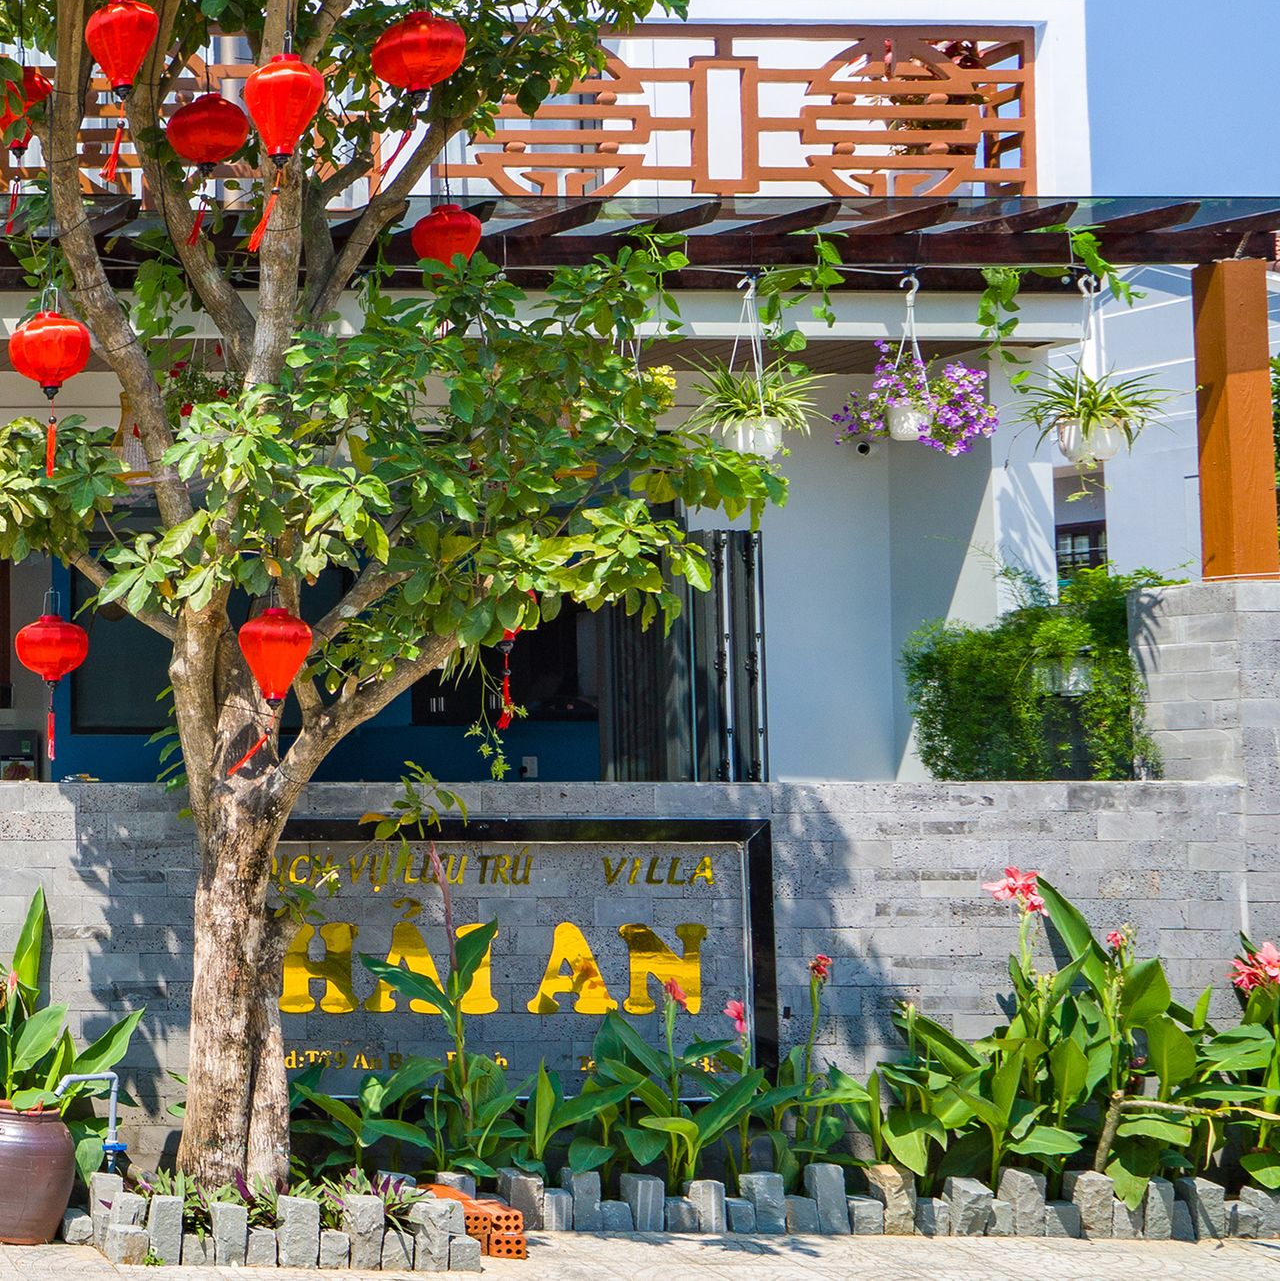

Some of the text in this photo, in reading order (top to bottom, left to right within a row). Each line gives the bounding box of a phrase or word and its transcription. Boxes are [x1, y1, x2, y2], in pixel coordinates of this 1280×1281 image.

[478, 845, 533, 885] TRÚ
[601, 855, 716, 886] VILLA
[278, 896, 707, 1014] HẢI AN
[351, 1052, 382, 1070] An
